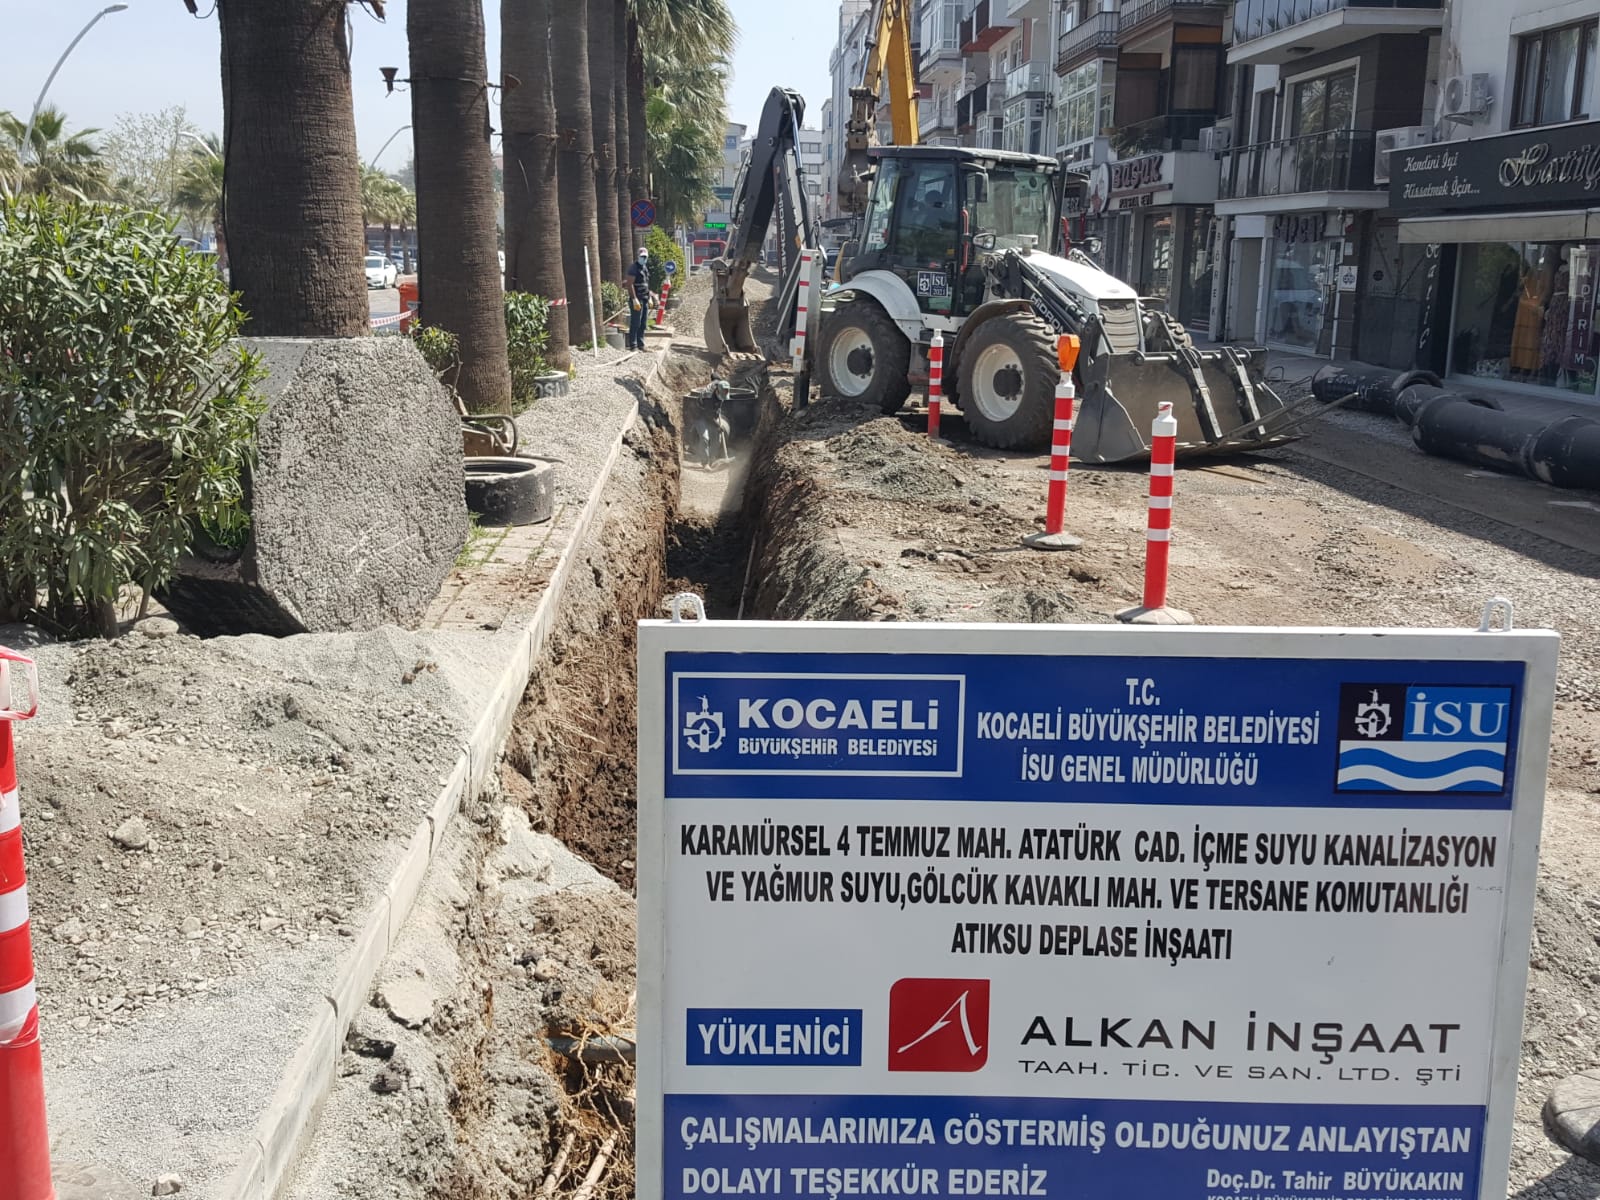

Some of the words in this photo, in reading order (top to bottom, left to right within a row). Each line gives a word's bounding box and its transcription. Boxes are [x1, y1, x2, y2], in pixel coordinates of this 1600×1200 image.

[1403, 154, 1440, 172] Kendini
[1126, 678, 1161, 706] T.C.
[977, 706, 1062, 740] KOCAELİ
[1068, 708, 1198, 749] BÜYÜKŞEHİR
[1203, 710, 1320, 745] BELEDİYESİ
[1408, 692, 1508, 737] İSU
[738, 737, 838, 759] BÜYÜKŞEHİR
[848, 738, 938, 756] BELEDİYESİ
[1021, 747, 1055, 781] İSU
[1060, 755, 1126, 784] GENEL
[1131, 751, 1259, 786] MÜDÜRLÜĞÜ
[681, 818, 831, 857] KARAMÜRSEL
[837, 825, 850, 856] 4
[857, 826, 951, 858] TEMMUZ
[957, 827, 1013, 860] MAH.
[1018, 822, 1121, 862] ATATÜRK
[1134, 831, 1186, 864] CAD.
[1193, 824, 1248, 872] İÇME
[1254, 833, 1317, 866] SUYU
[1324, 827, 1497, 868] KANALİZASYON
[706, 871, 735, 901] VE
[741, 863, 834, 903] YAĞMUR
[1005, 874, 1100, 908] KAVAKLI
[1107, 877, 1163, 909] MAH.
[1170, 878, 1199, 910] VE
[1206, 880, 1309, 912] TERSANE
[1315, 875, 1470, 914] KOMUTANLIĞI
[951, 923, 1033, 955] ATIKSU
[1040, 924, 1138, 957] DEPLASE
[1144, 919, 1233, 966] İNŞAATI
[698, 1017, 850, 1056] YÜKLENİCİ
[1020, 1015, 1216, 1051] ALKAN
[1246, 1010, 1461, 1065] İNŞAAT
[1018, 1060, 1109, 1076] TAAH.
[1122, 1060, 1180, 1078] TİC.
[1195, 1065, 1233, 1079] VE
[1248, 1066, 1322, 1081] SAN.
[1338, 1068, 1400, 1082] LTD.
[1415, 1065, 1461, 1087] ŞTİ
[681, 1117, 936, 1151] ÇALIŞMALARIMIZA
[944, 1113, 1106, 1154] GÖSTERMİŞ
[1114, 1117, 1291, 1152] OLDUĞUNUZ
[1298, 1126, 1472, 1160] ANLAYIŞTAN
[683, 1167, 782, 1195] DOLAYI
[790, 1162, 940, 1200] TEŞEKKÜR
[948, 1163, 1049, 1196] EDERİZ
[1207, 1168, 1277, 1193] Doç.Dr.
[1283, 1171, 1333, 1190] Tahir
[1343, 1167, 1464, 1191] BÜYÜKAKIN
